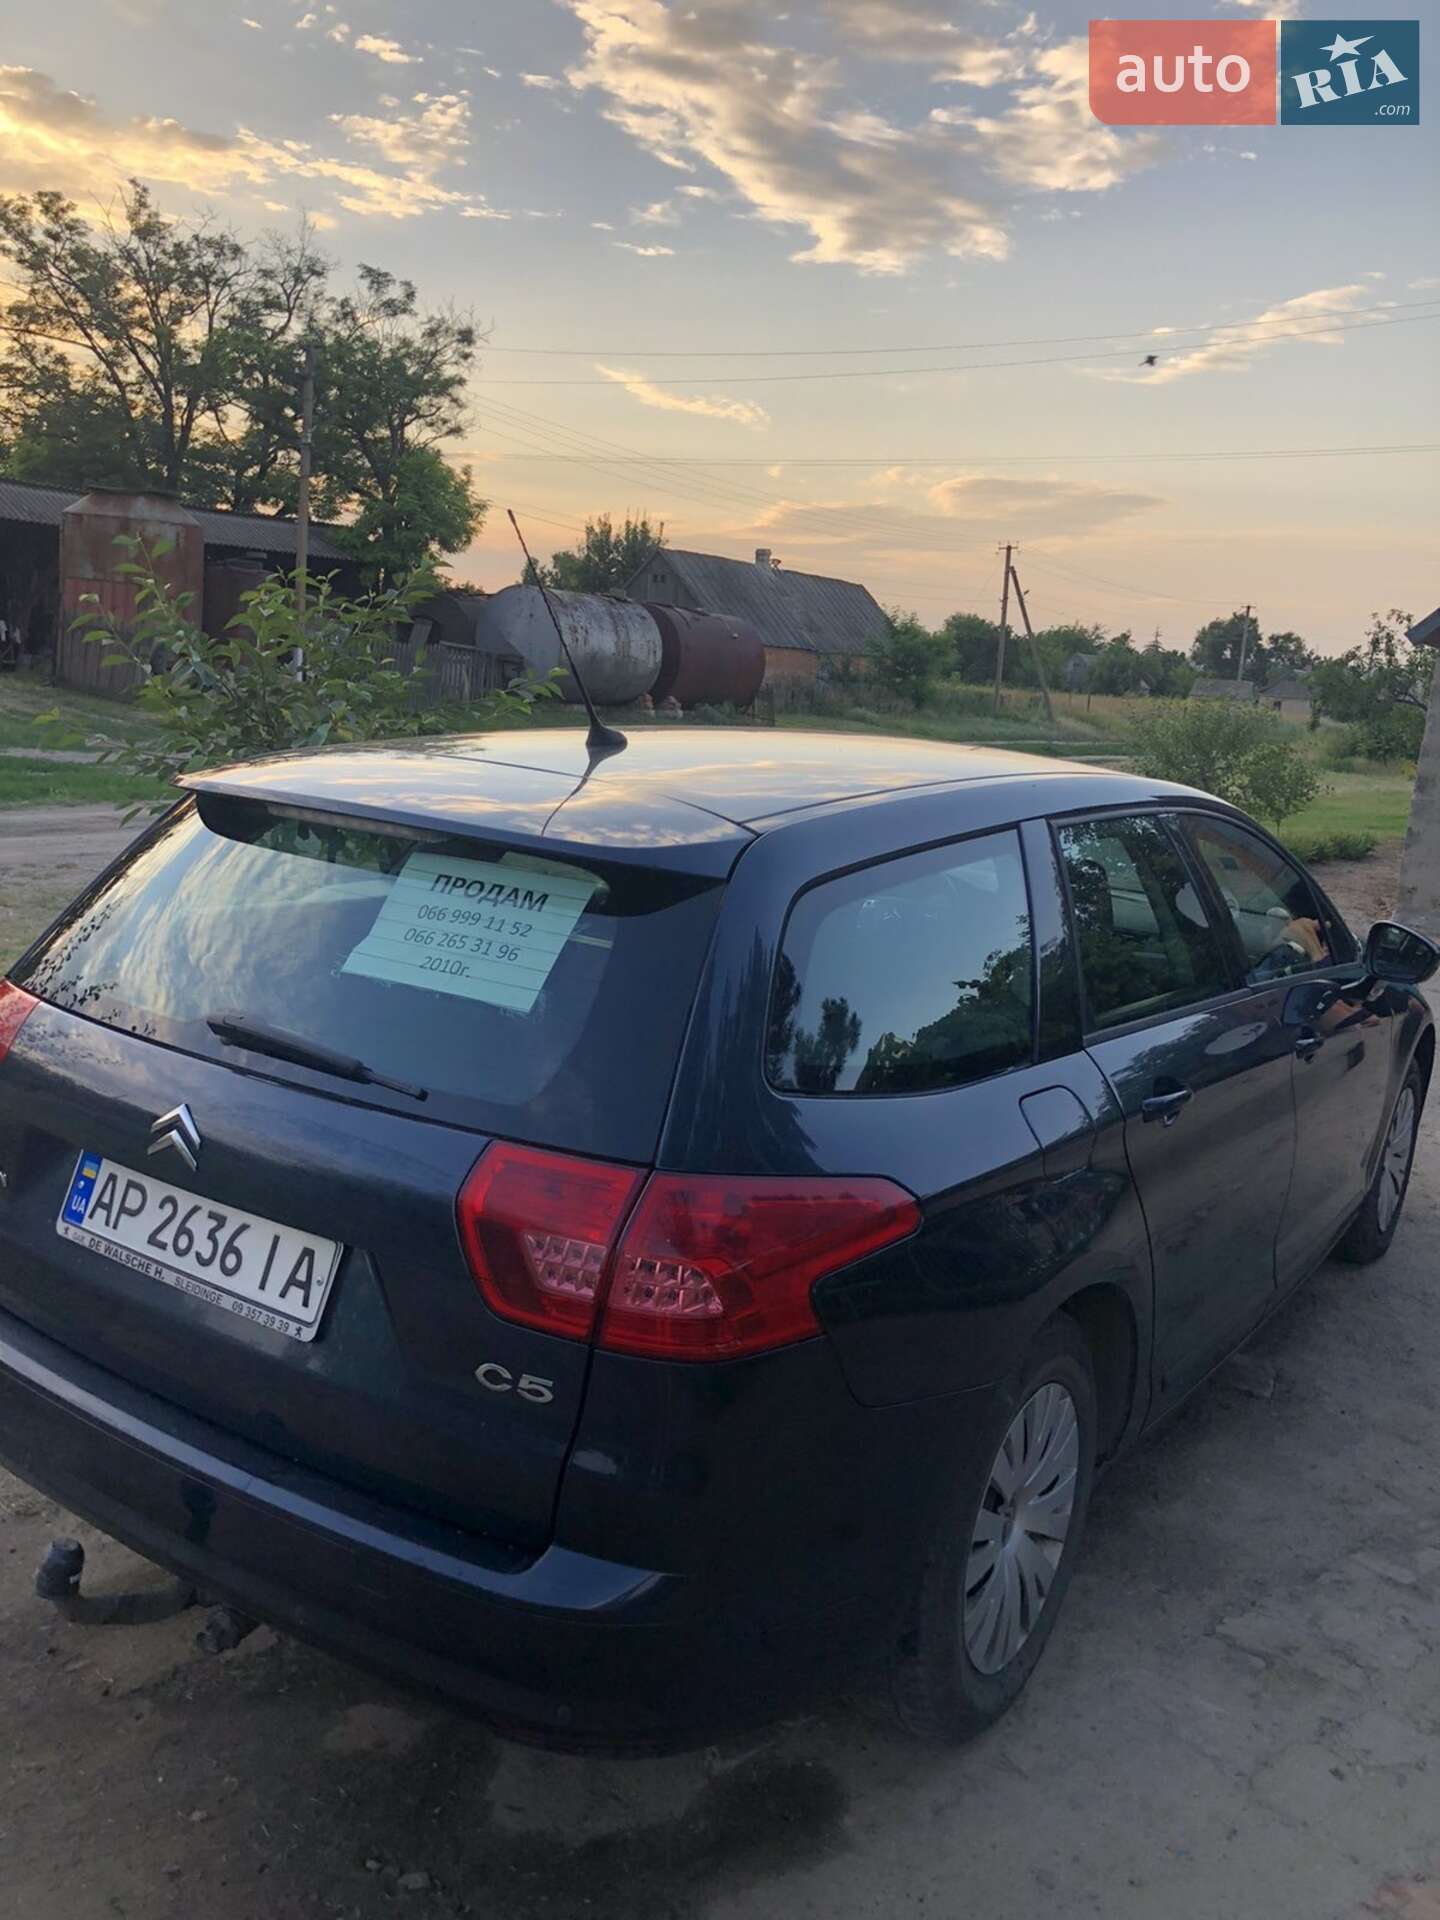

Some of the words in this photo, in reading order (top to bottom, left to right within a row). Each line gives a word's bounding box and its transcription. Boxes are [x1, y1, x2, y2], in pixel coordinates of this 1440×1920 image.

[429, 874, 550, 912] ПРОДАМ
[417, 904, 446, 921] 066
[449, 909, 481, 926] 999
[482, 916, 504, 933] 11
[510, 921, 534, 938] 52
[403, 927, 434, 945] 066
[437, 932, 467, 950] 265
[470, 939, 490, 956] 31
[496, 944, 519, 962] 96
[71, 1195, 86, 1214] UA
[88, 1172, 148, 1230] AP
[146, 1194, 251, 1277] 2636
[258, 1235, 316, 1308] IA
[88, 1238, 102, 1251] DE
[103, 1243, 154, 1274] WALSCHE
[475, 1363, 554, 1403] C5
